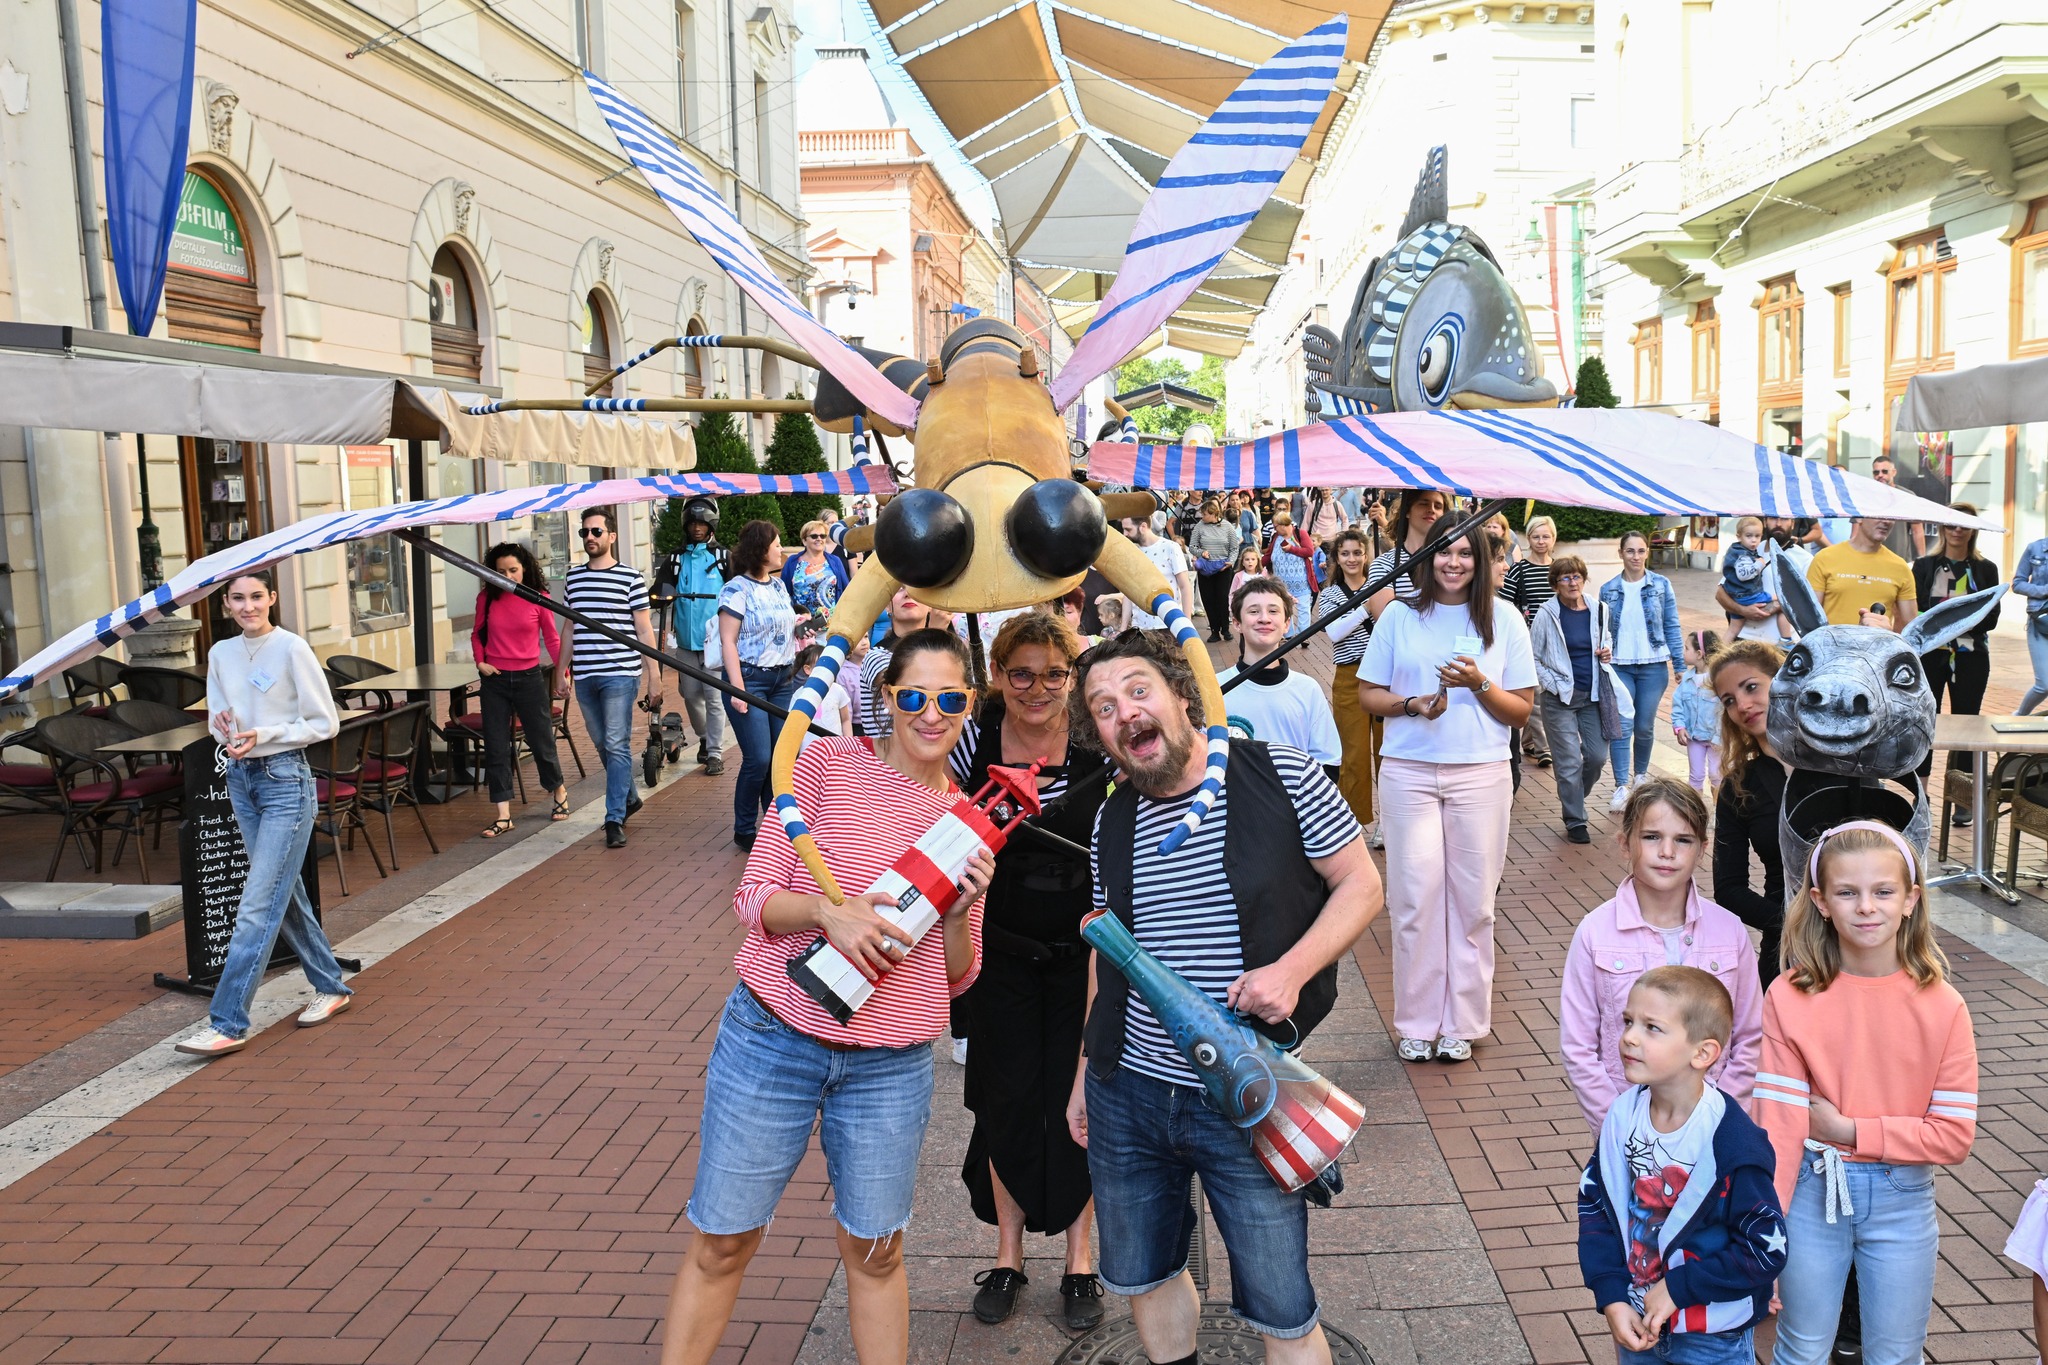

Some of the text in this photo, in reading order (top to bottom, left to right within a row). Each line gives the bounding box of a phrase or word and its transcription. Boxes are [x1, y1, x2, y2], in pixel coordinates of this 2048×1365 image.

[176, 201, 227, 231] JIFILM
[199, 813, 224, 826] Fried
[199, 828, 231, 840] Chicken
[200, 840, 232, 851] Chicken
[200, 850, 231, 861] Chicken
[201, 860, 227, 872] Lamb
[202, 872, 227, 884] Lamb
[205, 905, 225, 918] Beef
[205, 914, 230, 929] Daal
